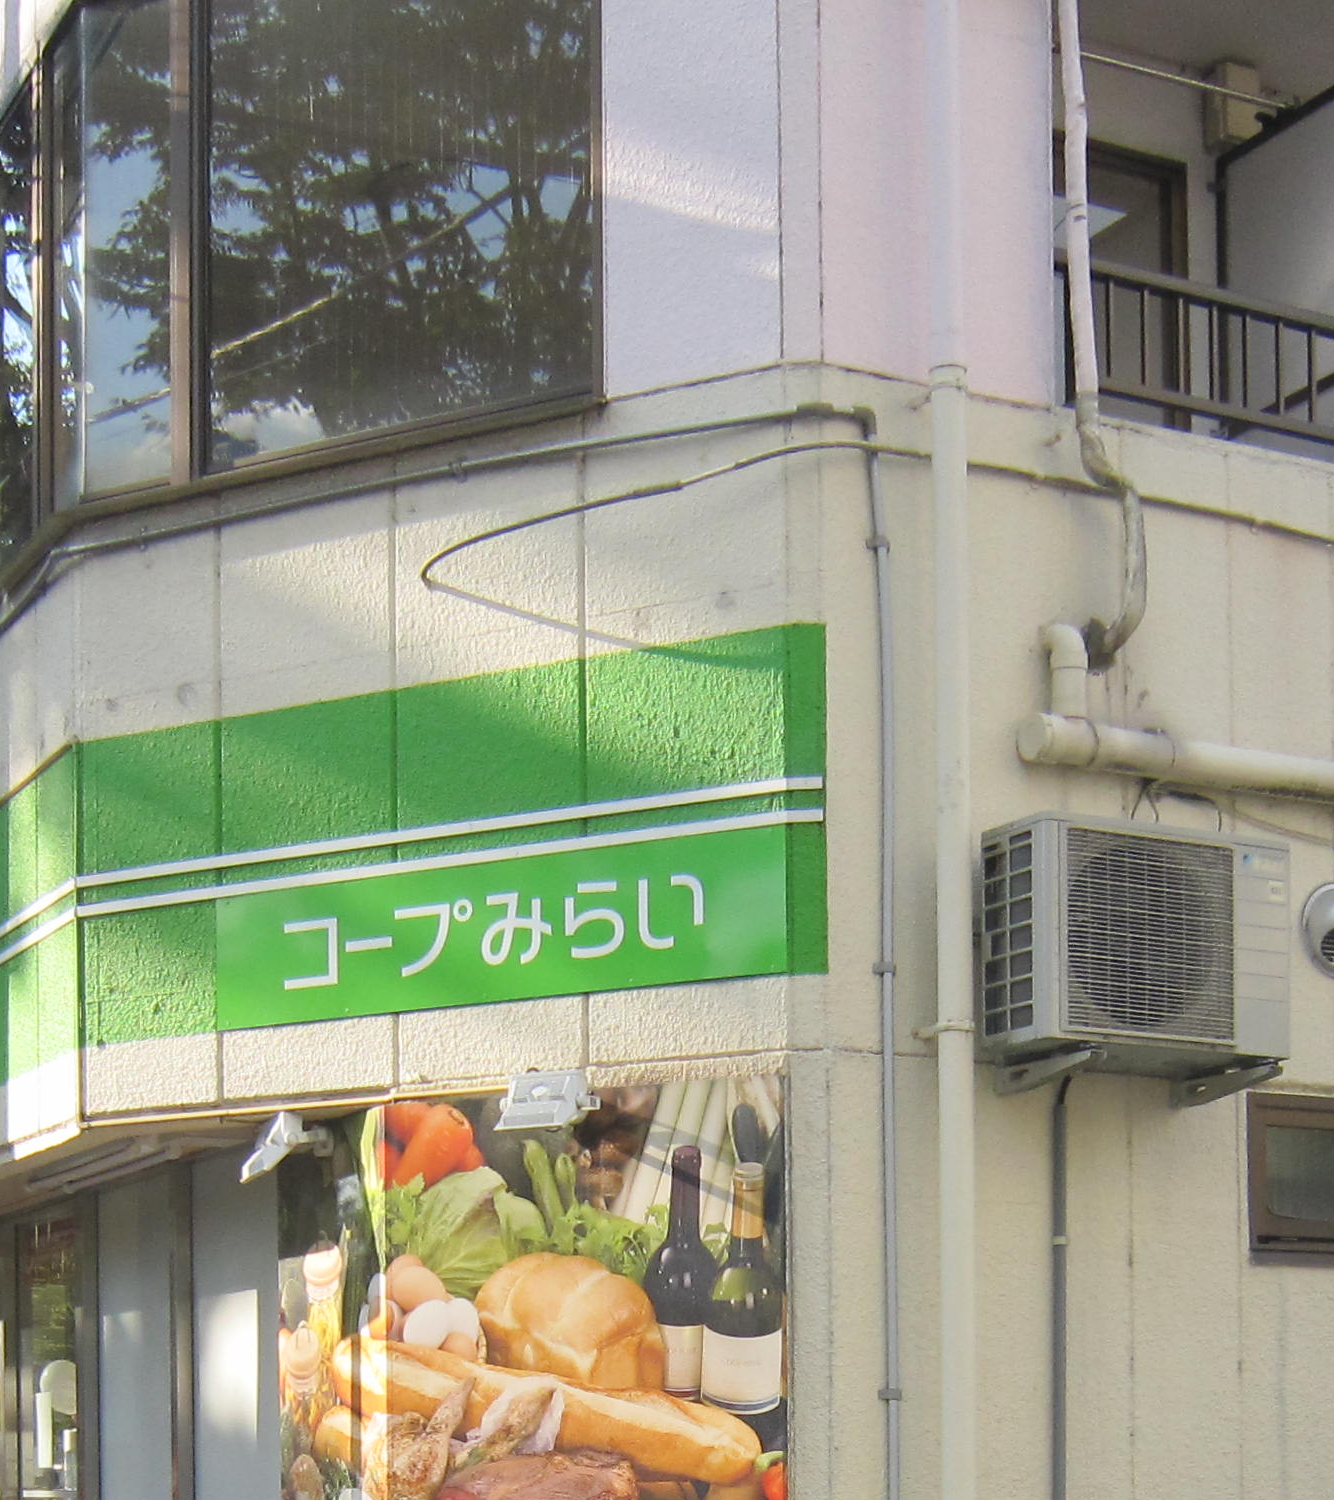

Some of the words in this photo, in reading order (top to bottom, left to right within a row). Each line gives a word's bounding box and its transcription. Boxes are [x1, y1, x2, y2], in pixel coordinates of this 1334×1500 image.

[283, 873, 705, 991] コープみらい
